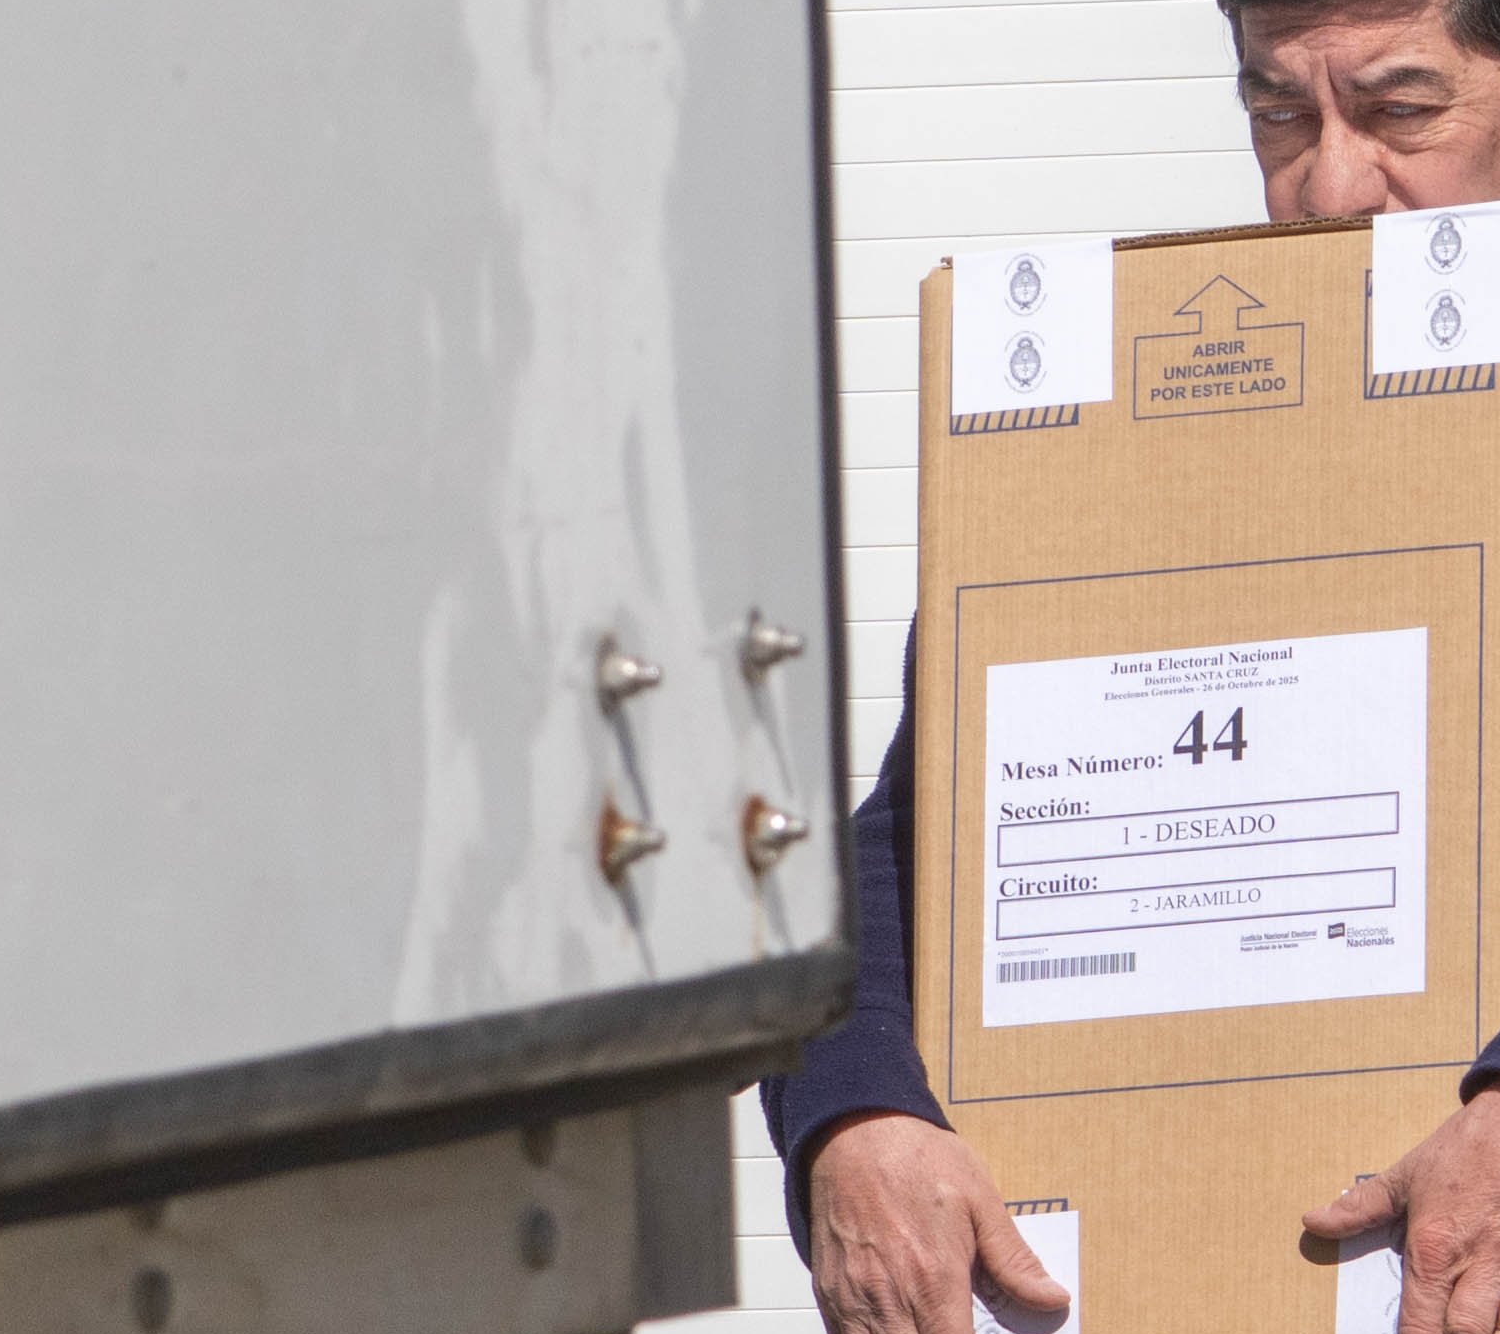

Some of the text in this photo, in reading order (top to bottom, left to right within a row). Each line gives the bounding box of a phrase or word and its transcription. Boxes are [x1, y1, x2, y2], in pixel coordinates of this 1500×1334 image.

[1192, 340, 1245, 358] ABRIR
[1163, 358, 1274, 381] UNICAMENTE
[1150, 377, 1286, 402] POR ESTE LADO
[1110, 646, 1293, 676] Junta Electoral Nacional
[1104, 690, 1149, 701] Elecciones
[1151, 685, 1194, 697] Generales
[1203, 684, 1213, 692] 26
[1214, 681, 1225, 691] de
[1227, 678, 1263, 690] Octubre
[1265, 677, 1276, 687] de
[1278, 675, 1299, 685] 2025
[1144, 667, 1259, 687] Distrito SANTA CRUZ
[1000, 706, 1248, 782] Mesa Número: 44
[999, 797, 1091, 822] Sección:
[1122, 825, 1131, 846] 1
[1154, 813, 1277, 844] DESEADO
[998, 871, 1100, 899] Circuito:
[1129, 897, 1140, 914] 2
[1153, 887, 1262, 912] JARAMILLO
[1346, 935, 1395, 948] Nacionales
[1347, 926, 1389, 938] Elecciones
